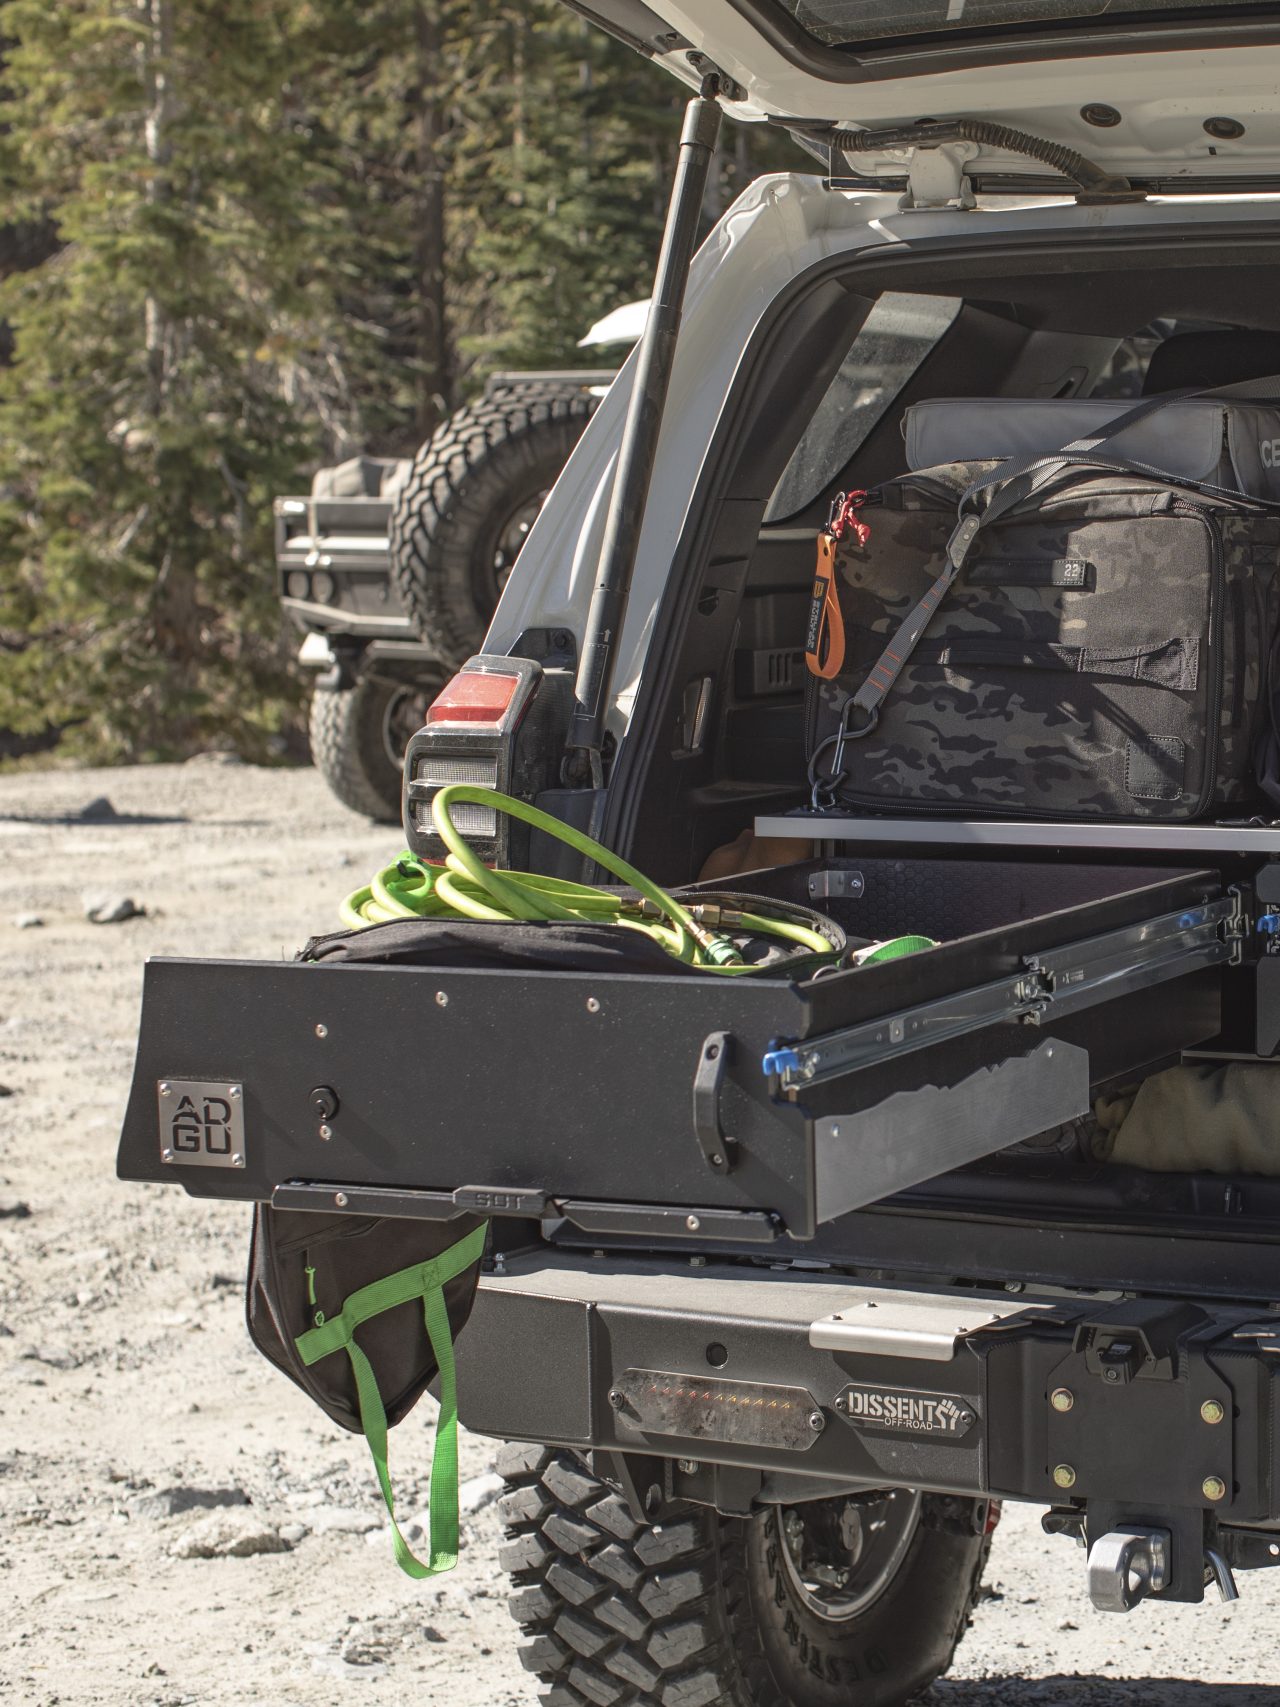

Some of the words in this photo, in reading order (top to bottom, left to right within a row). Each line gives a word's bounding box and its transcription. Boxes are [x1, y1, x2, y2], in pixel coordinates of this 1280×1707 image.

[1064, 563, 1079, 577] 22
[171, 1095, 232, 1126] AD
[848, 1391, 938, 1422] DISSENT
